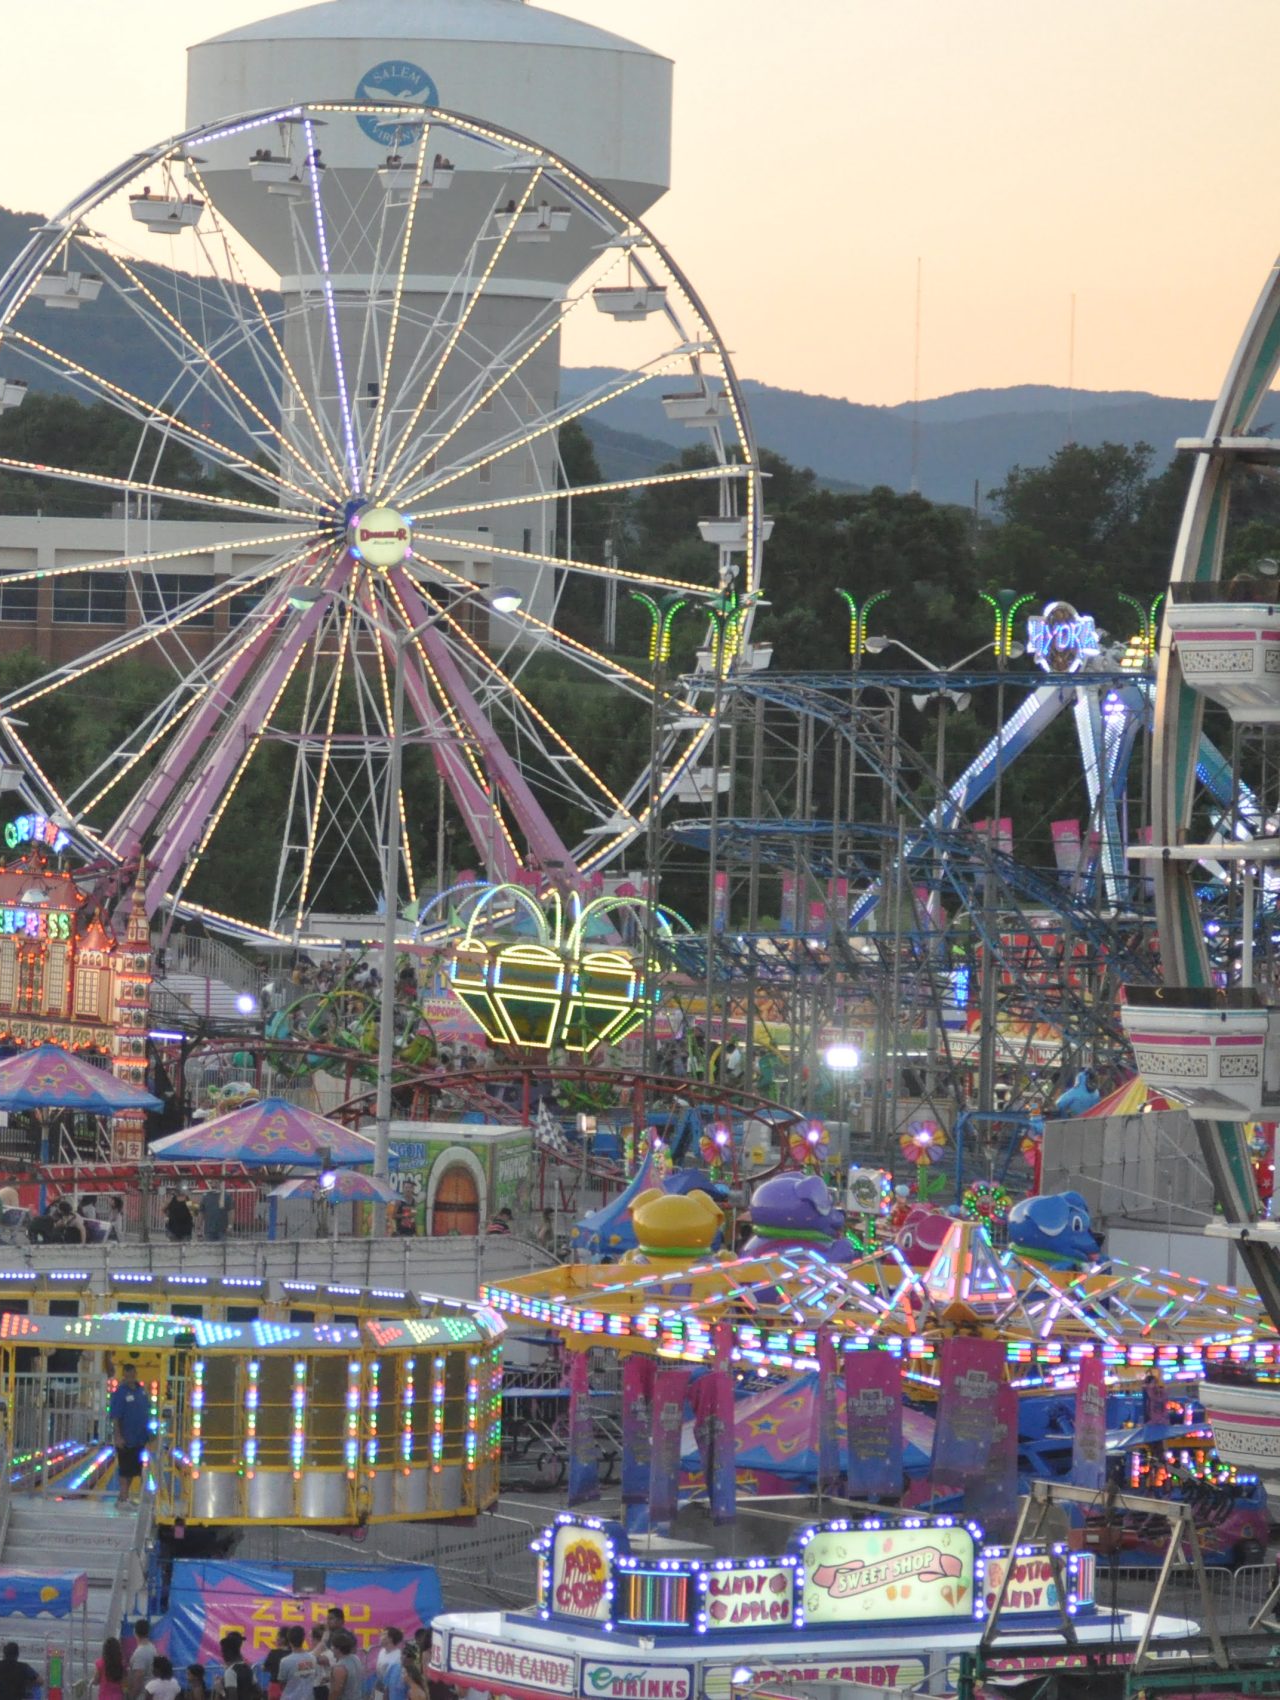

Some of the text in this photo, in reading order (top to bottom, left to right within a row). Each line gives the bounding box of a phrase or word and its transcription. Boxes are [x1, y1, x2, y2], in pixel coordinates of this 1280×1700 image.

[373, 65, 421, 84] SALEM
[565, 1545, 602, 1577] POP
[837, 1550, 934, 1593] SWEET SHOP
[709, 1574, 768, 1596] CANDY
[730, 1600, 789, 1623] APPLES
[455, 1643, 516, 1674] COTTON
[519, 1655, 569, 1688] CANDY
[611, 1679, 688, 1699] DRINKS
